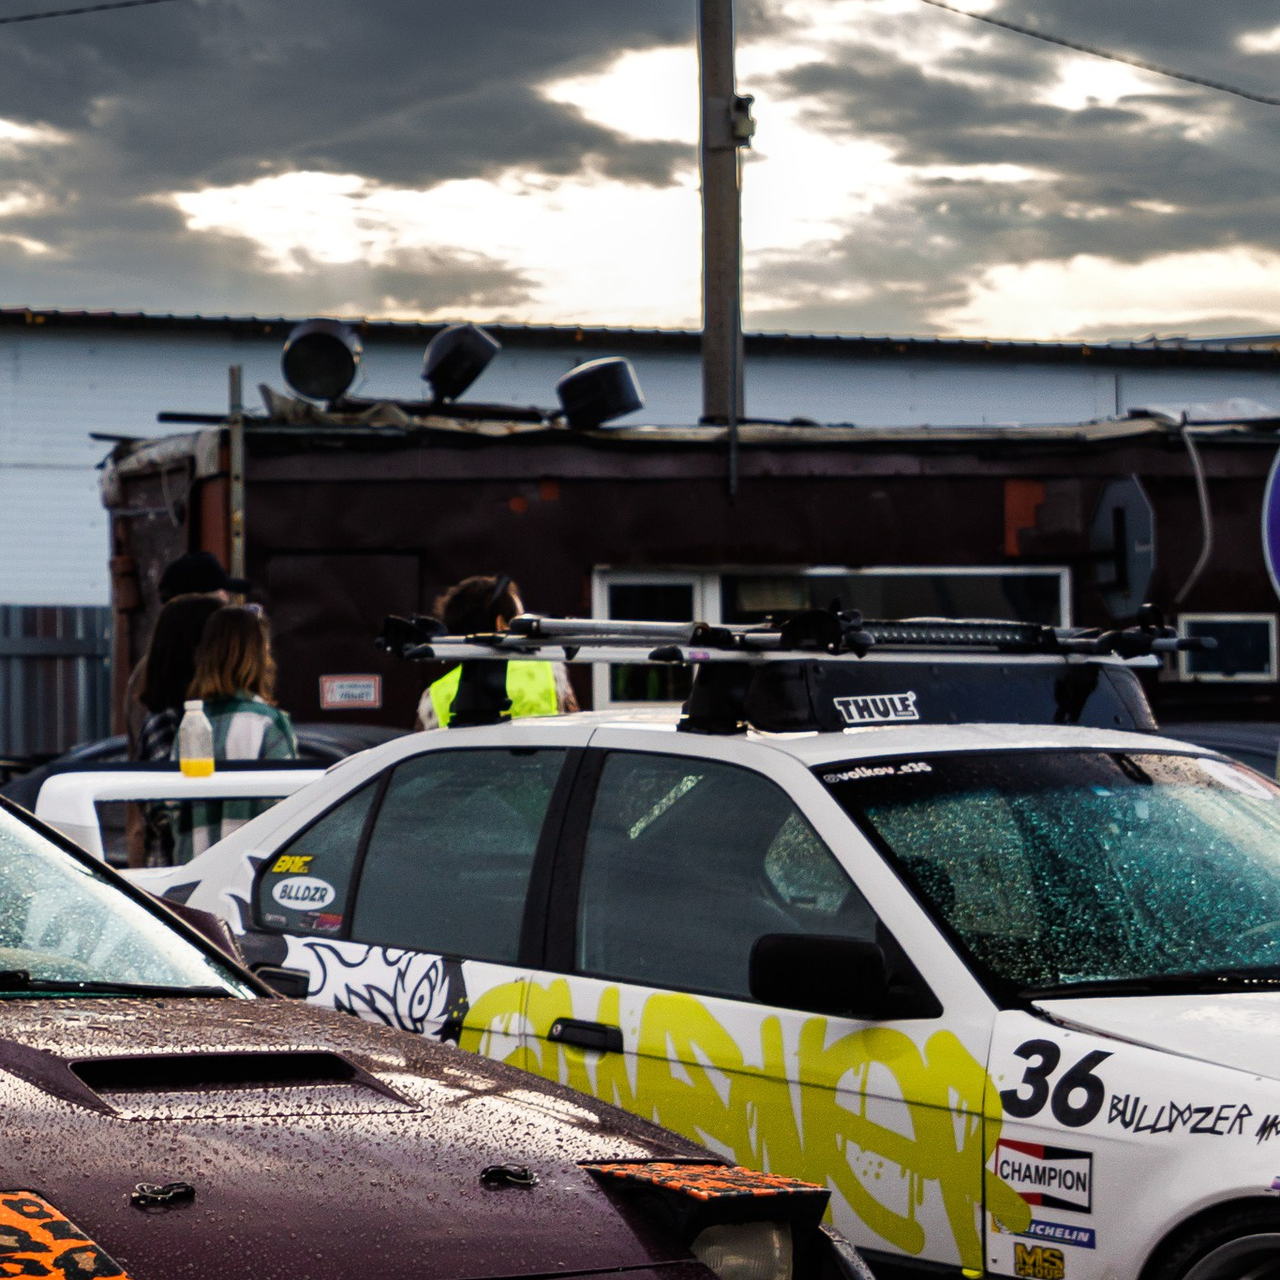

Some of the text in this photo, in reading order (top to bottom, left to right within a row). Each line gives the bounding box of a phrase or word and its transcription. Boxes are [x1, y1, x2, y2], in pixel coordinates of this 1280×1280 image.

[835, 695, 915, 720] THULE
[279, 884, 328, 903] BLLDZR
[999, 1038, 1115, 1128] 36
[1107, 1093, 1253, 1136] BULLDOZER
[1000, 1159, 1087, 1193] CHAMPION
[1027, 1223, 1090, 1242] ICHELIN
[1014, 1242, 1064, 1270] MS
